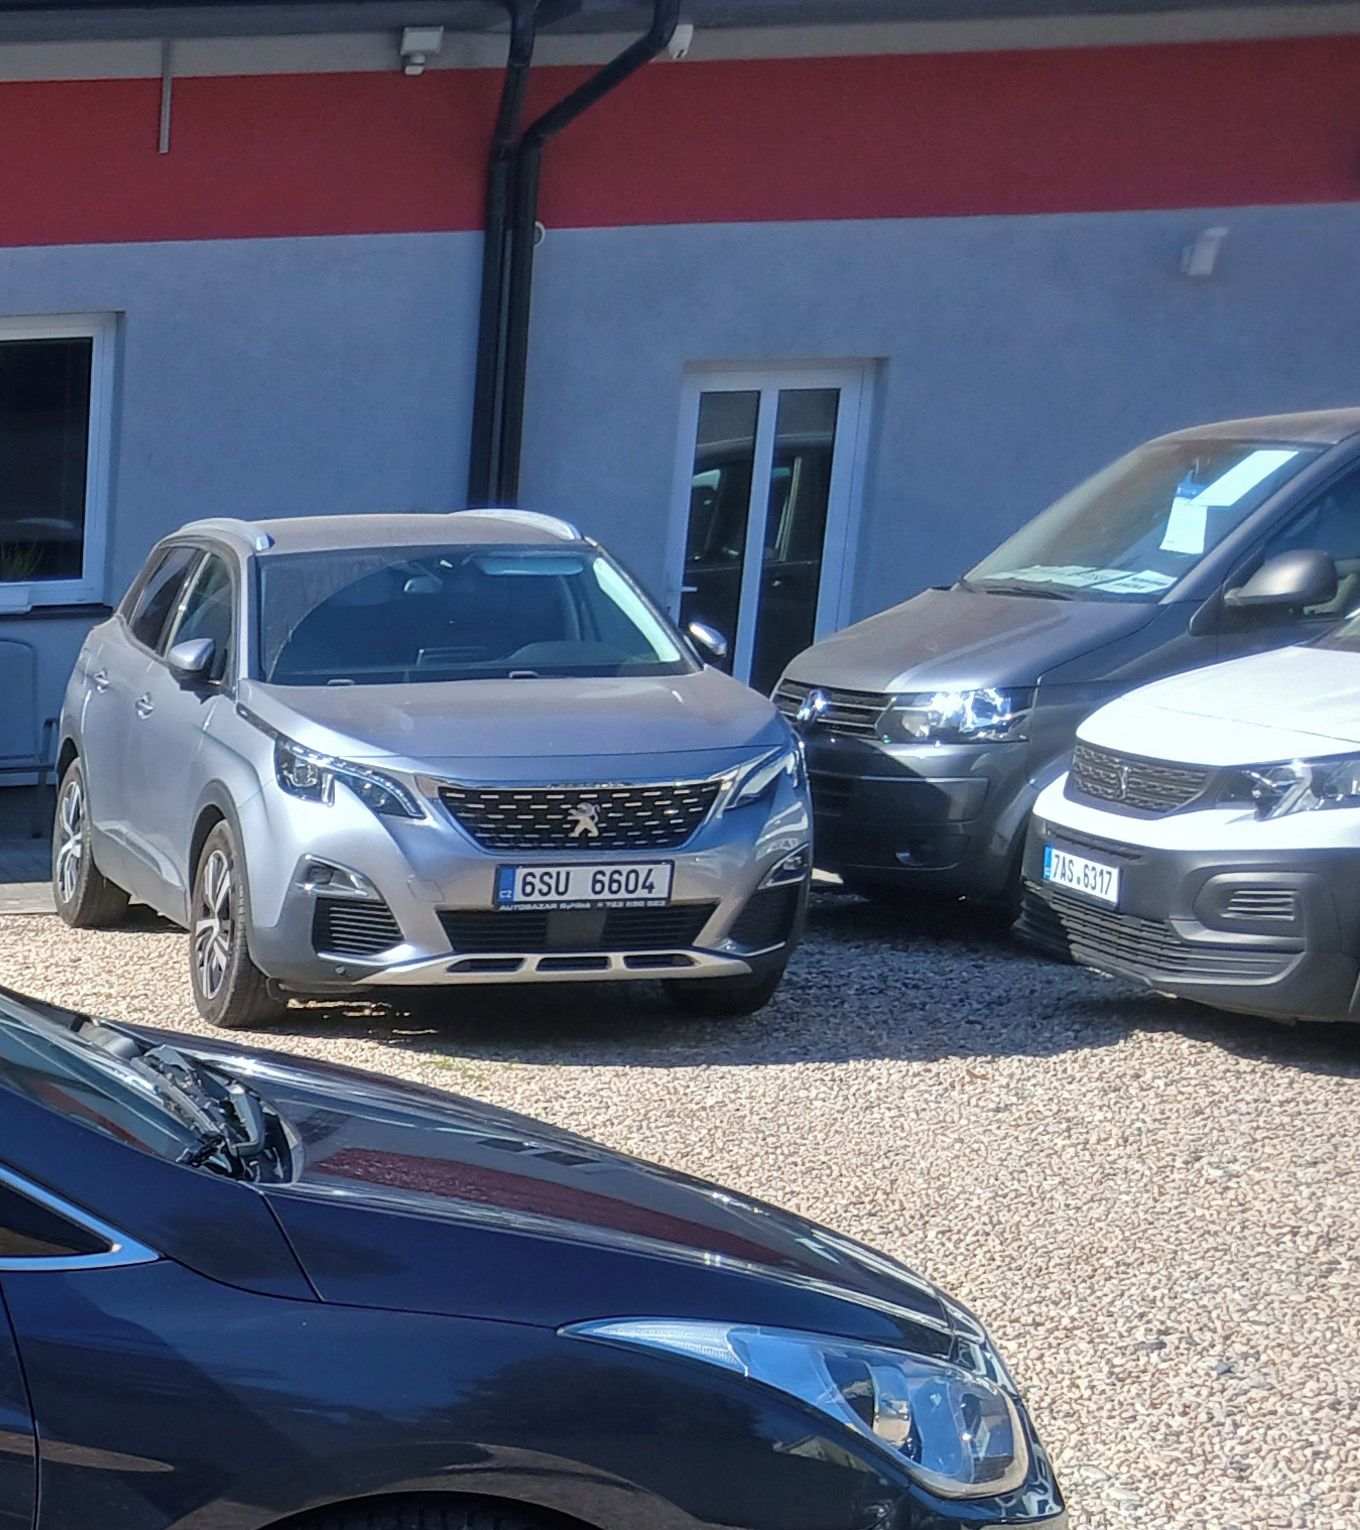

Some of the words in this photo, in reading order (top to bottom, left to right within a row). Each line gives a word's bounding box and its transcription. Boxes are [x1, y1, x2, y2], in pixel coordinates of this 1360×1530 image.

[521, 871, 571, 897] 6SU
[591, 868, 655, 895] 6604
[1083, 863, 1112, 895] 6317
